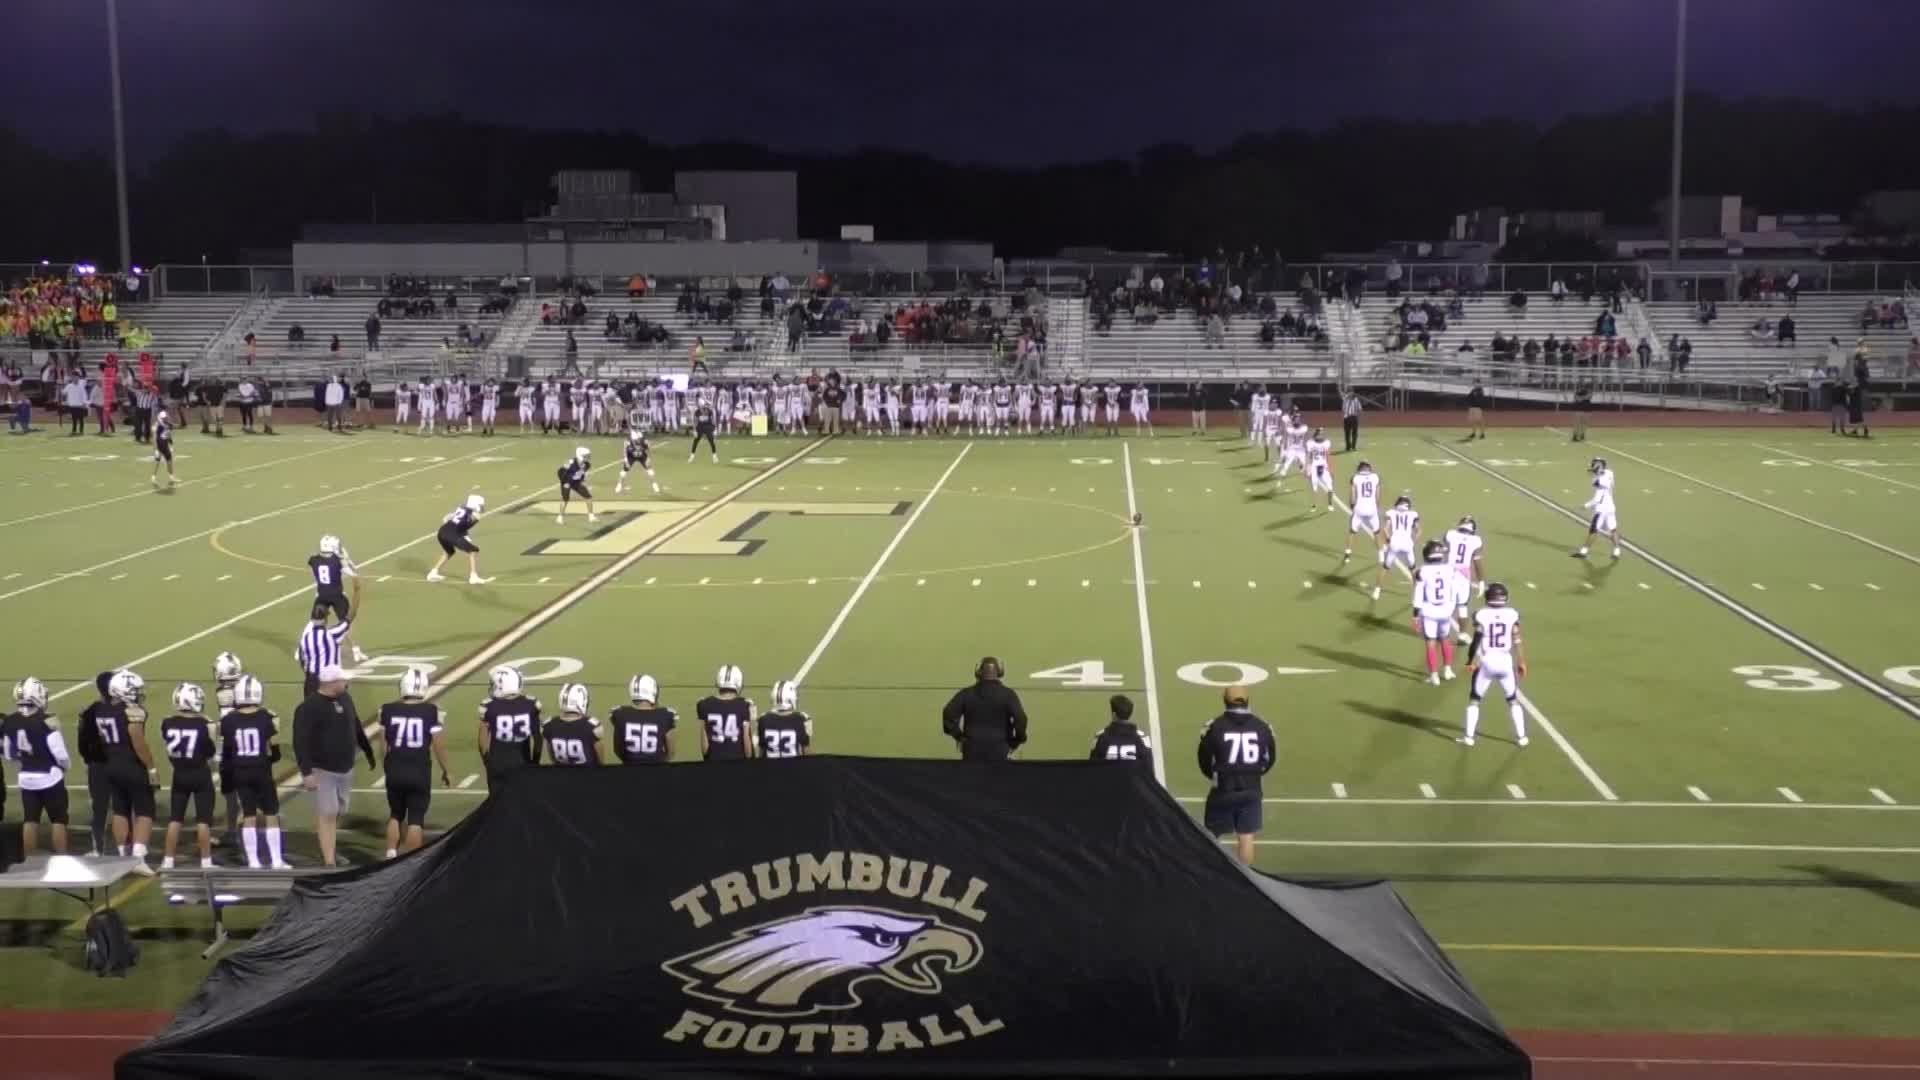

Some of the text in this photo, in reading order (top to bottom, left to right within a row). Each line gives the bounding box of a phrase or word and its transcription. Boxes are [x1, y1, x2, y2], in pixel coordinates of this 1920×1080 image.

[1455, 543, 1466, 564] 9
[317, 564, 331, 585] 8
[1435, 577, 1445, 600] 2
[1488, 622, 1507, 648] 12
[234, 727, 261, 757] 10
[390, 716, 423, 748] 70
[495, 713, 531, 743] 83
[624, 722, 658, 753] 56
[706, 713, 739, 743] 34
[165, 728, 198, 759] 27
[551, 737, 587, 765] 89
[764, 729, 797, 758] 33
[1223, 732, 1259, 764] 76
[670, 850, 989, 928] TRUMBULL
[662, 1003, 1005, 1054] FOOTBALL
